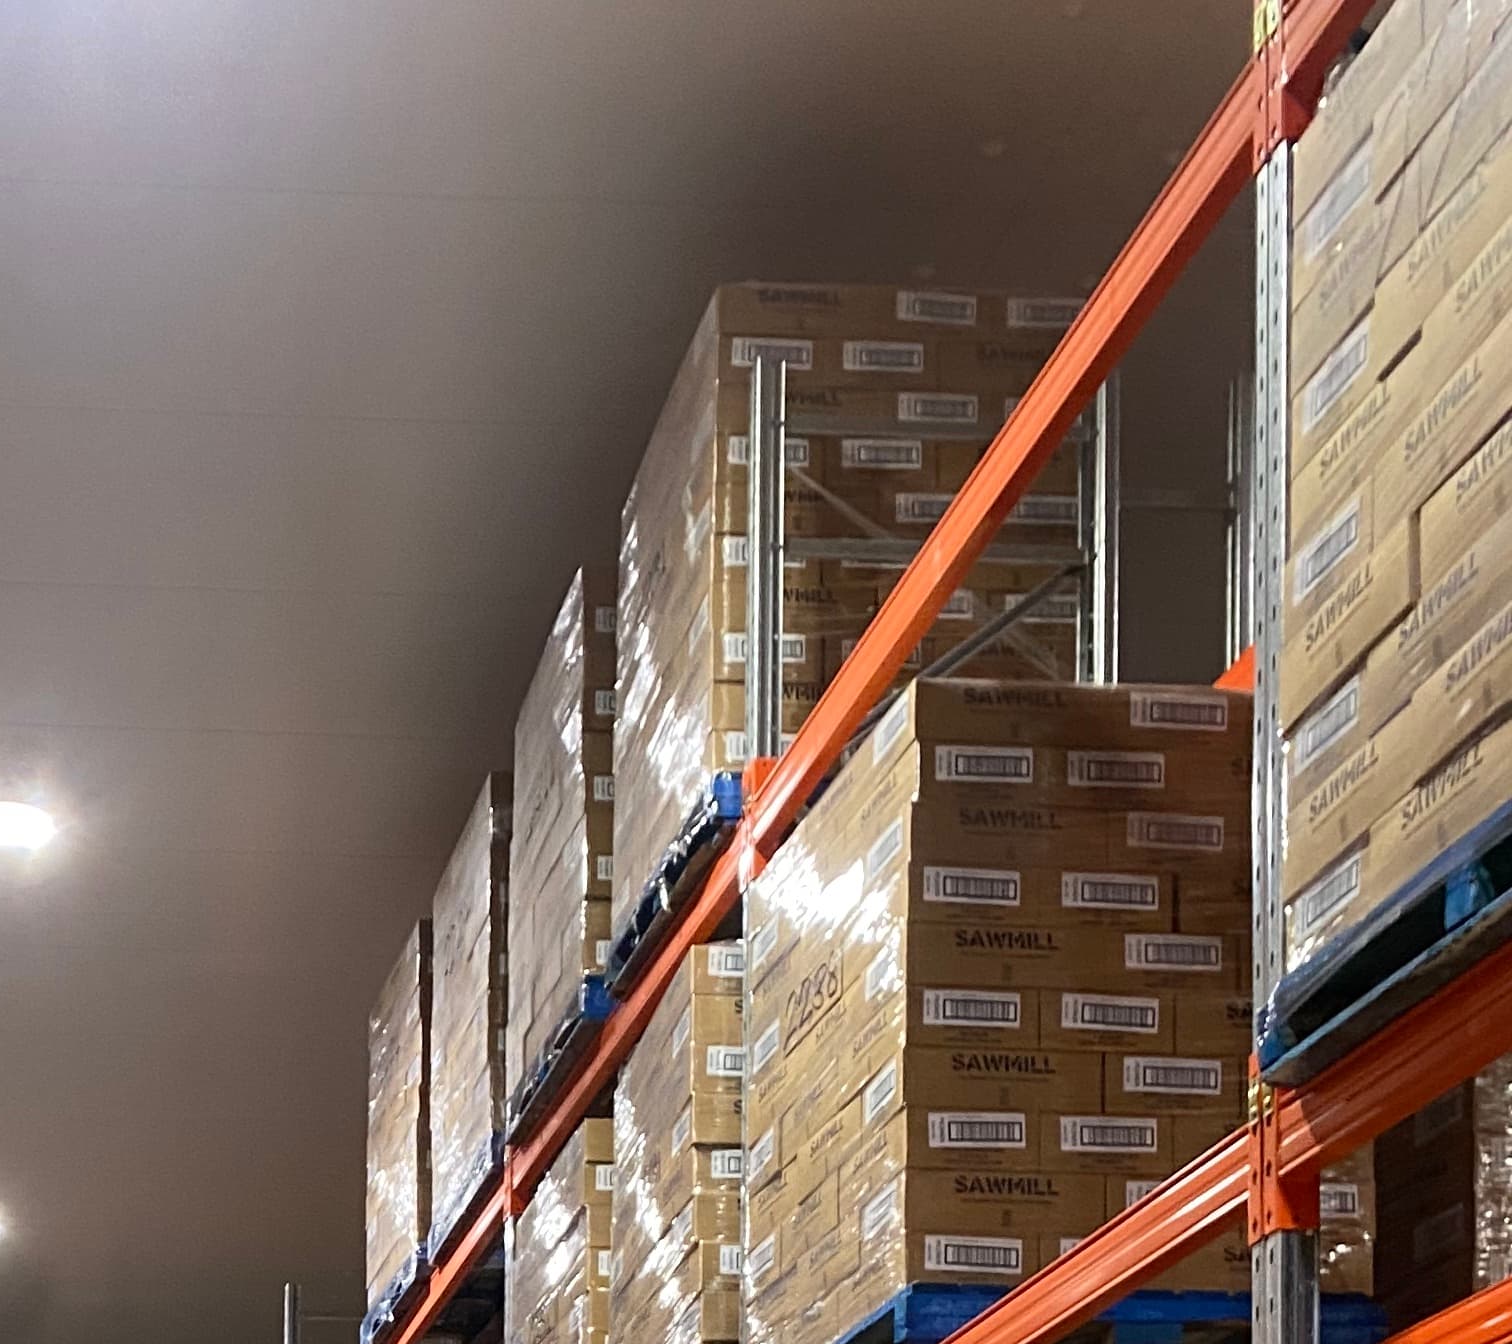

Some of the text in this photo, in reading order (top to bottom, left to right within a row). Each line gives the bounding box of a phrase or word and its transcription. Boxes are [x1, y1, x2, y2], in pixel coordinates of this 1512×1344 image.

[1305, 563, 1374, 652] SAWMILL
[1309, 739, 1379, 822] SAWMILL
[960, 808, 1062, 830] SAWMILL
[955, 930, 1058, 950] SAWMILL
[952, 1054, 1056, 1074] SAWMILL
[954, 1175, 1059, 1196] SAWMILL
